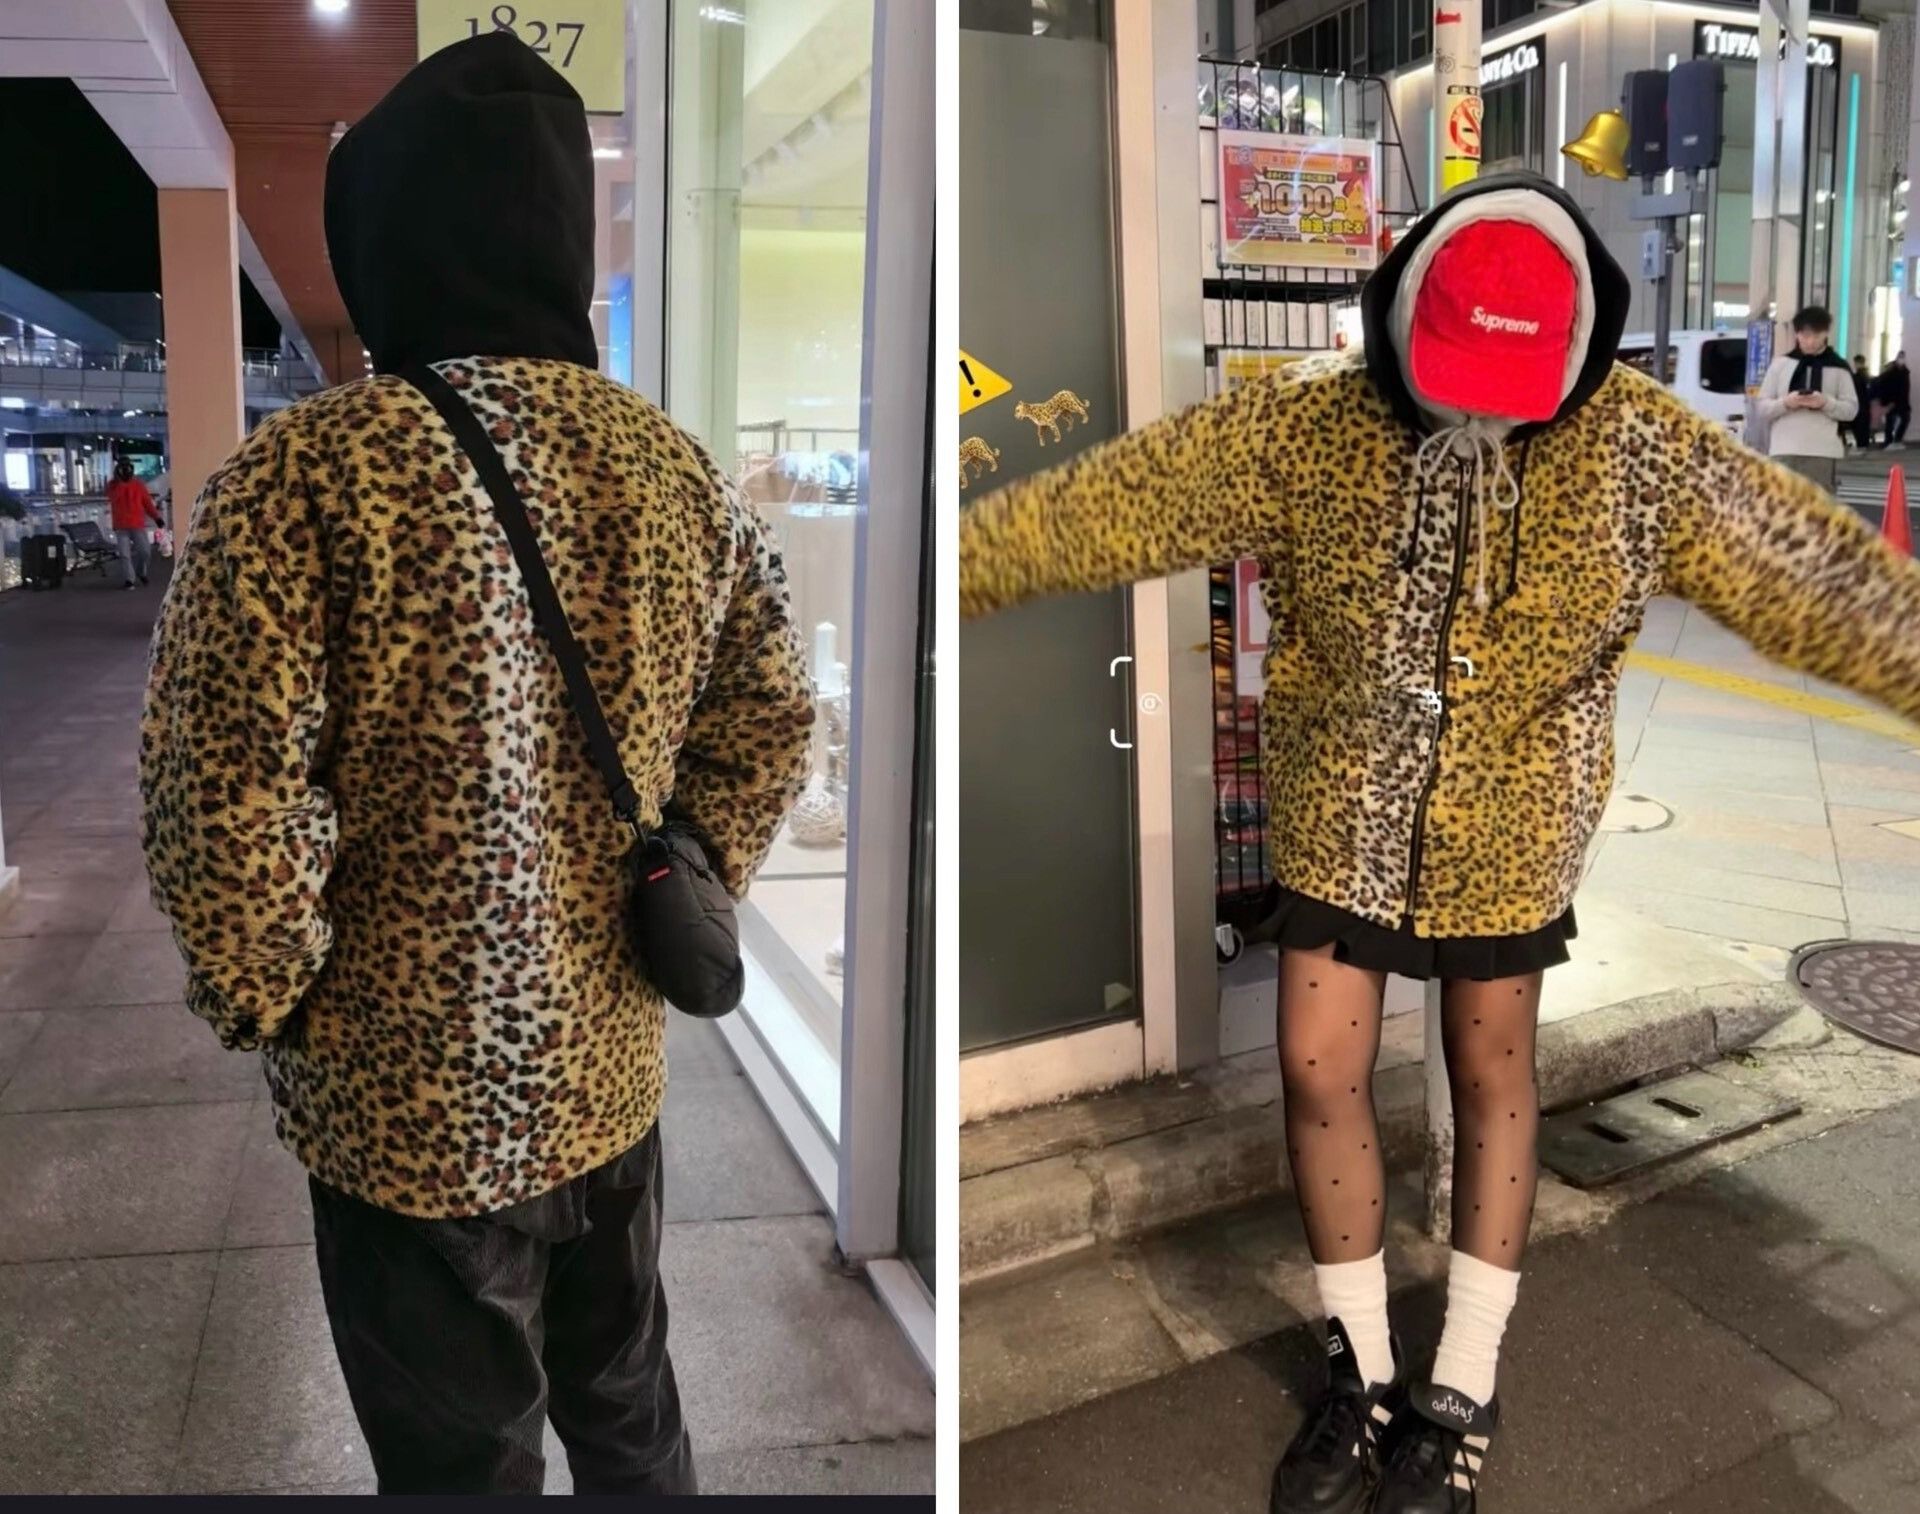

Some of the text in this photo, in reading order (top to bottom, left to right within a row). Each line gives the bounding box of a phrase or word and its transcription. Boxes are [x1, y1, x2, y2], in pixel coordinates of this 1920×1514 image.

[464, 4, 586, 68] 1827
[1470, 305, 1540, 335] Supreme
[1432, 1394, 1475, 1424] adidas
